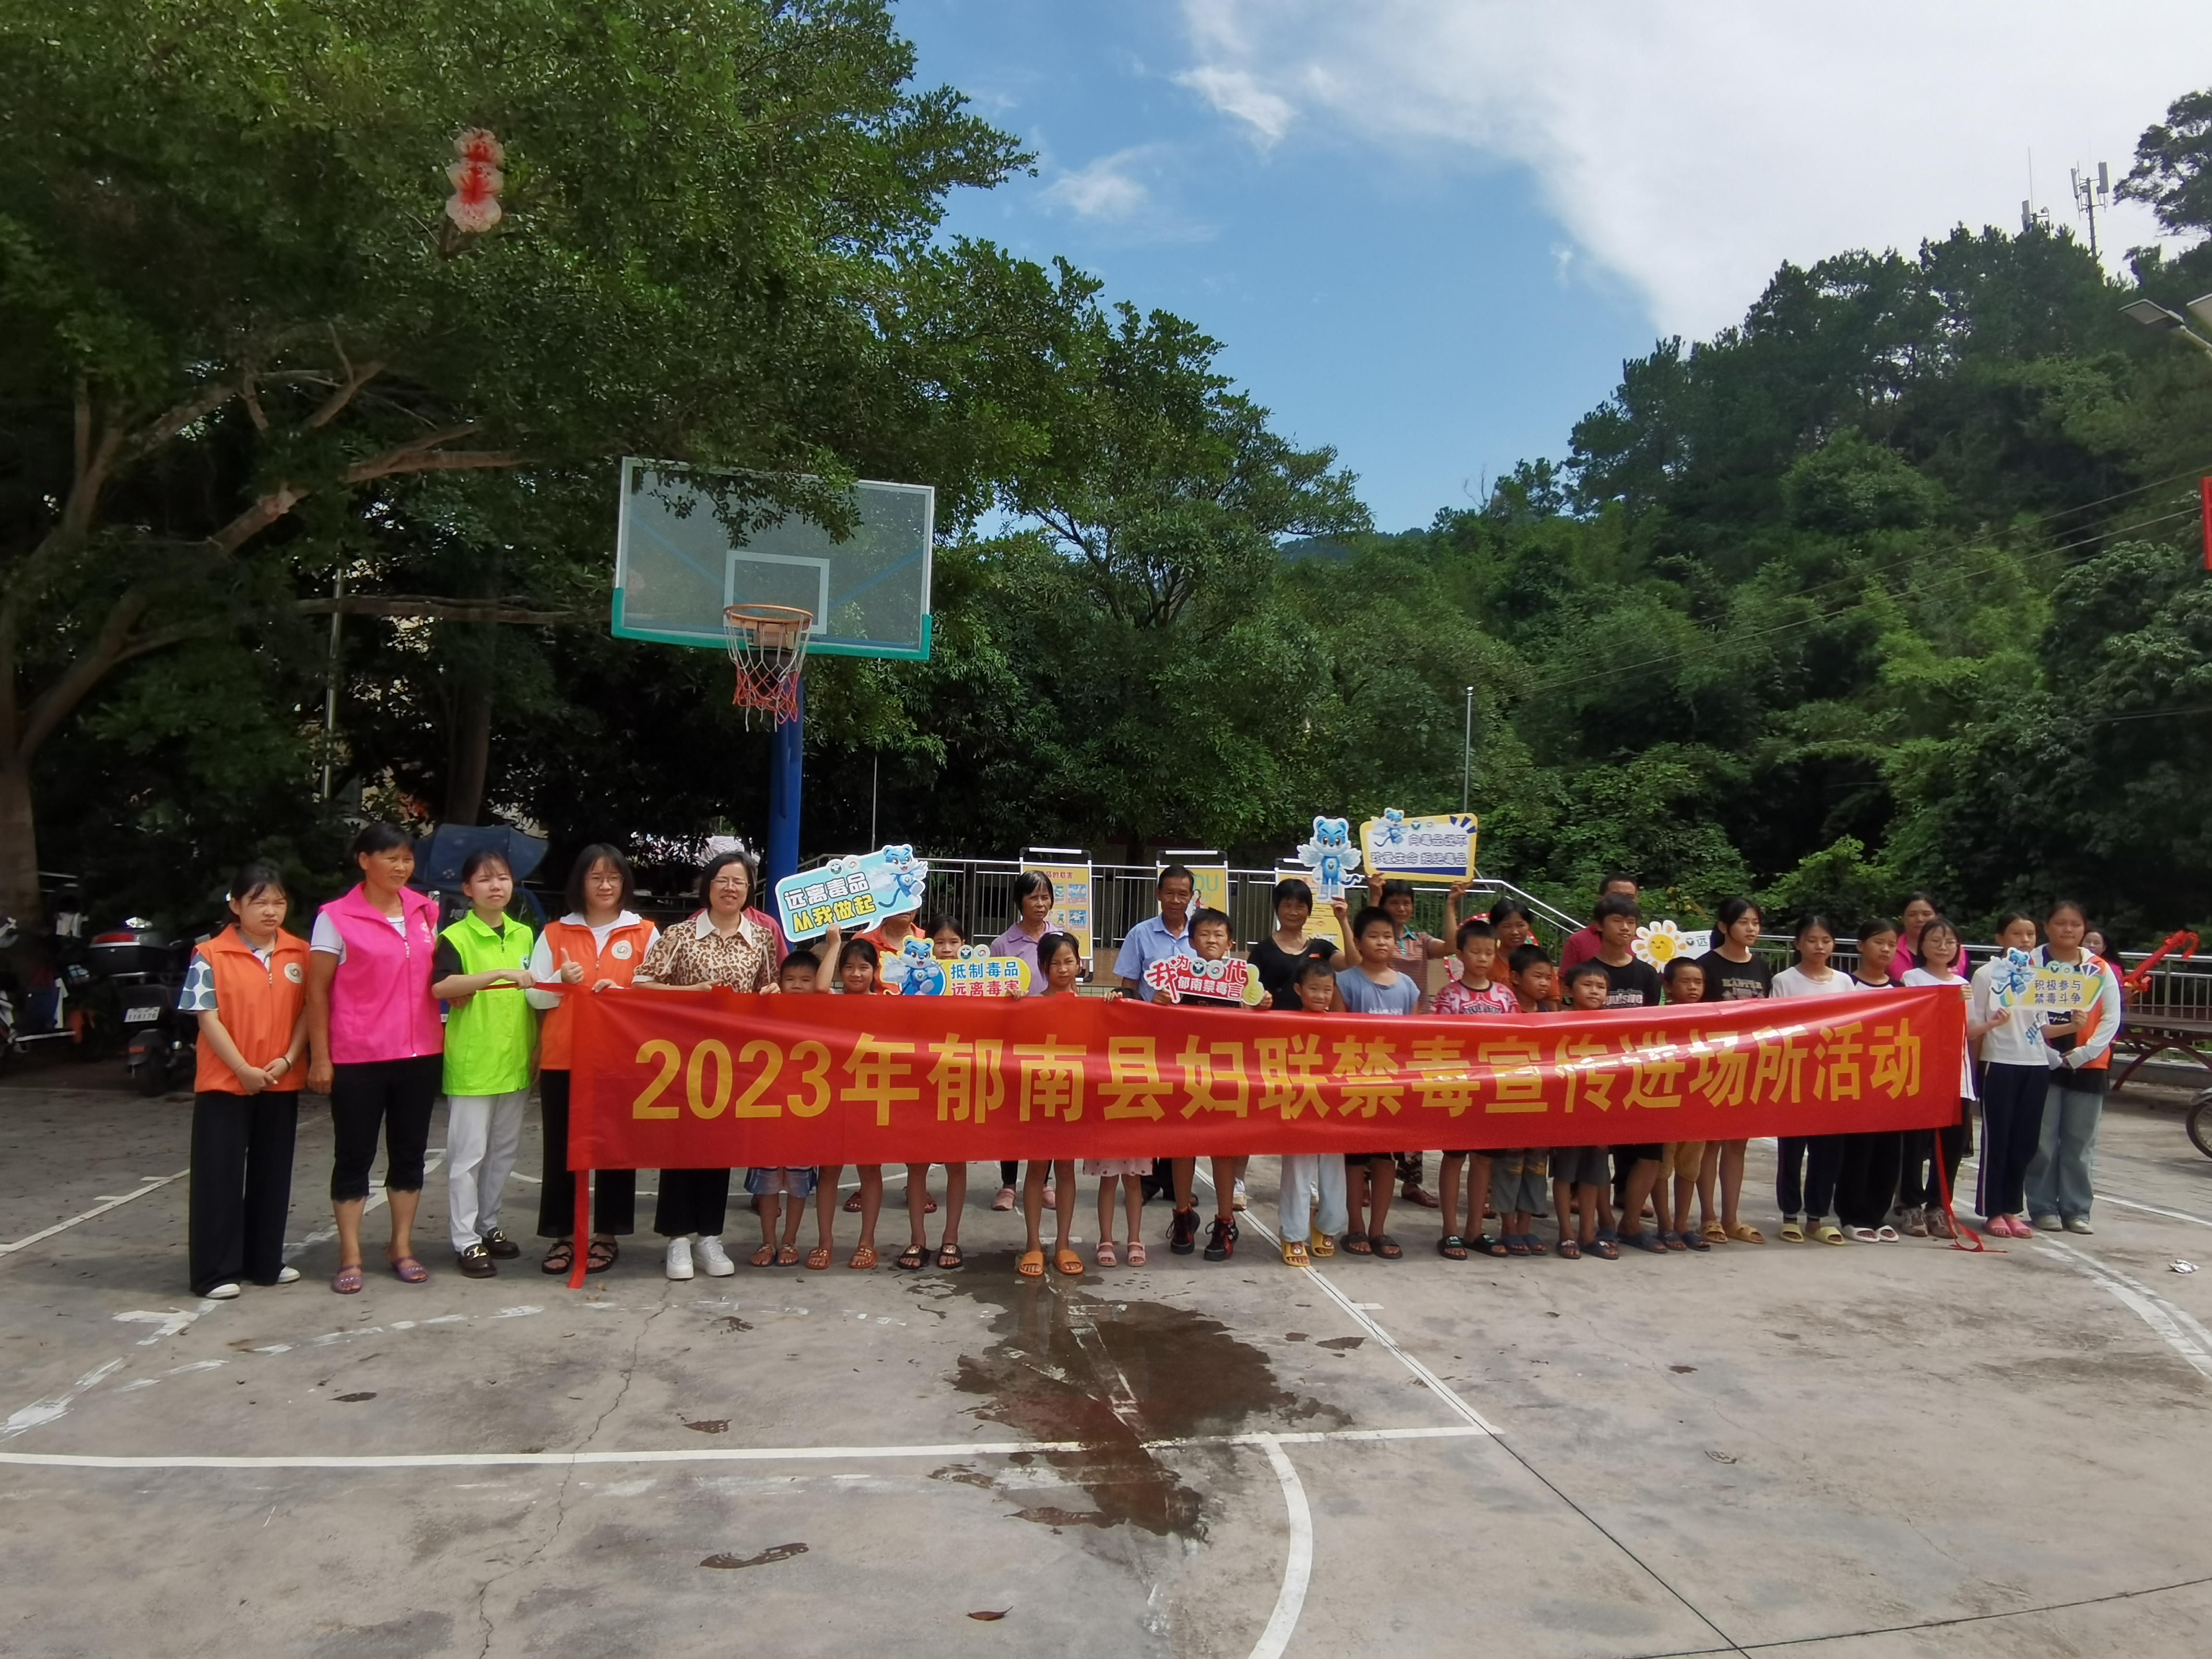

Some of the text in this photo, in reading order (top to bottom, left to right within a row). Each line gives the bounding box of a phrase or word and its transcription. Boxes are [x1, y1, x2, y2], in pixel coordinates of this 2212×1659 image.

[1370, 852, 1467, 865] 珍爱生命 拒绝毒品
[783, 871, 870, 911] 远离毒品
[792, 893, 877, 933] 从我做起
[950, 962, 1018, 979] 抵制毒品
[1178, 975, 1228, 995] 郁南禁毒
[2034, 979, 2081, 991] 积极参与
[2034, 993, 2081, 1004] 禁毒斗争
[632, 1017, 1922, 1127] 2023年郁南县妇联禁毒宣传进场所活动
